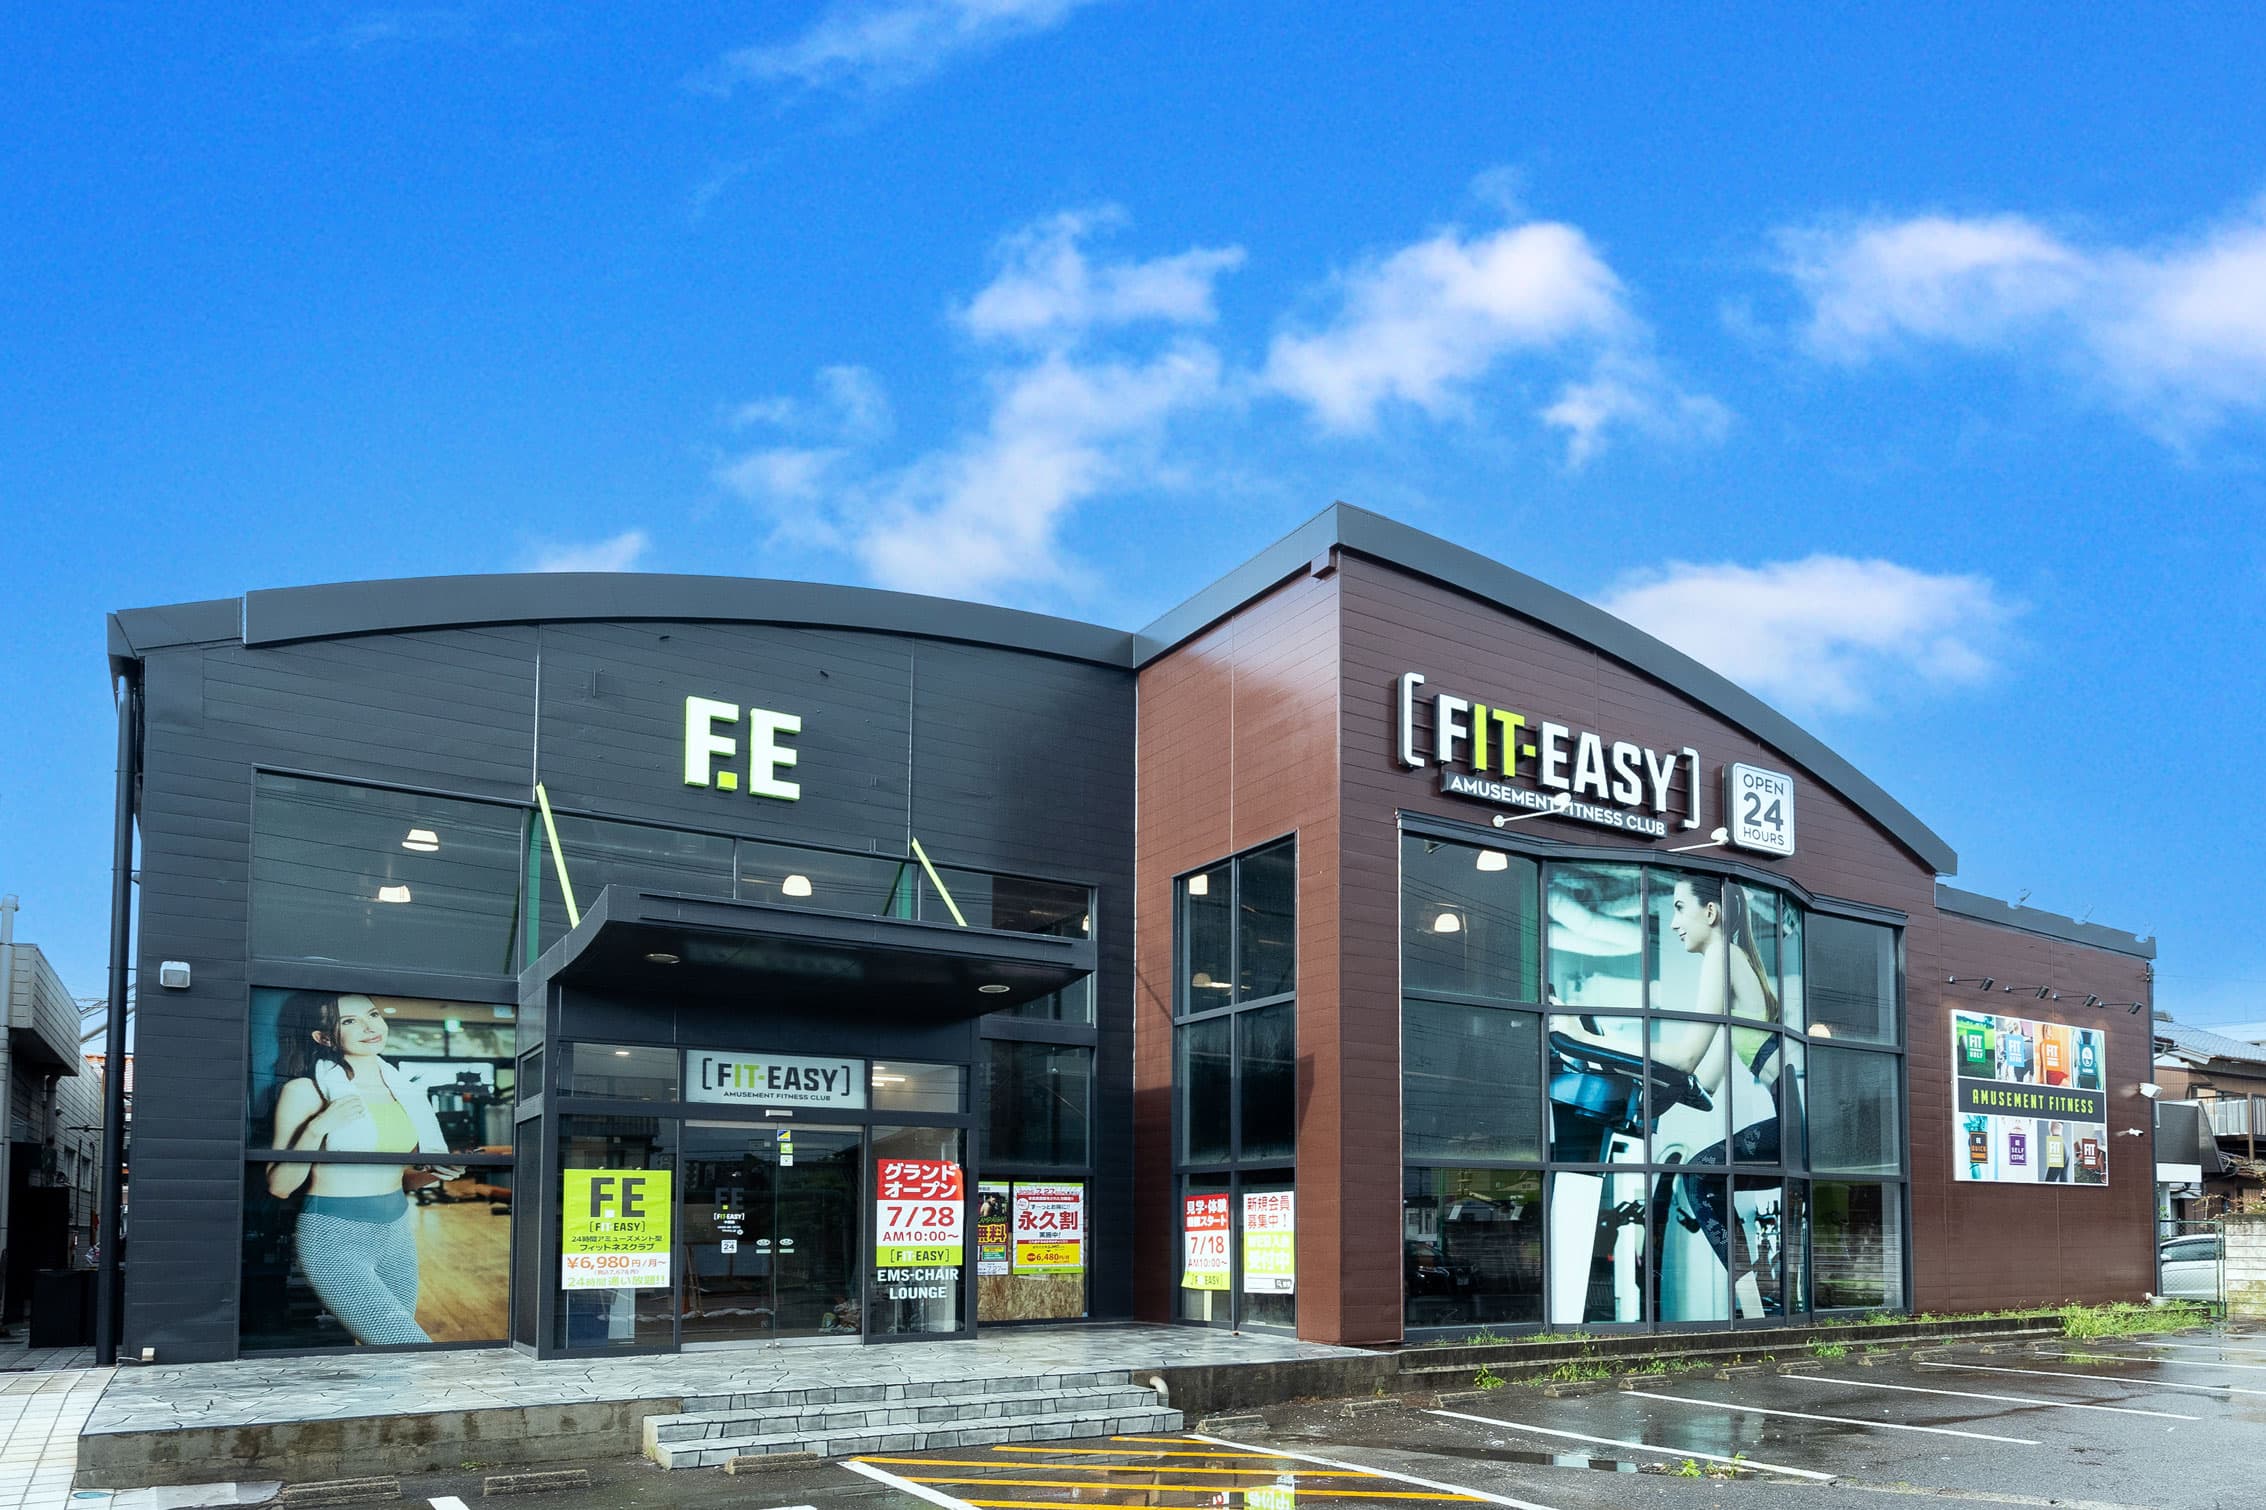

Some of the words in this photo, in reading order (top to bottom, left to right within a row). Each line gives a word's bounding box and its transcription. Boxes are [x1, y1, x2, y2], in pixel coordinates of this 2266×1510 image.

[685, 695, 801, 801] F.E
[1743, 773, 1784, 796] OPEN
[1451, 775, 1558, 811] AMUSEMENT
[1563, 803, 1623, 826] ITNESS
[1626, 815, 1665, 835] CLUB
[1743, 792, 1784, 832] 24
[1743, 827, 1785, 847] HOURS
[1969, 1034, 1983, 1049] FIT
[724, 1091, 774, 1099] AMUSEMENT
[1972, 1089, 2044, 1110] AMUSEMENT
[2049, 1096, 2094, 1114] FITNESS
[2084, 1143, 2096, 1156] FIT
[884, 1162, 960, 1181] グランド
[591, 1177, 646, 1218] F.E
[884, 1181, 957, 1198] オープン
[1247, 1196, 1290, 1212] 新規会員
[887, 1206, 955, 1228] 7/28
[1018, 1211, 1078, 1231] 永久割
[580, 1243, 655, 1251] フィットネスクラブ
[1191, 1236, 1224, 1255] 7/18
[877, 1268, 959, 1281] EMS-CHAIR
[889, 1286, 947, 1300] LOUNGE
